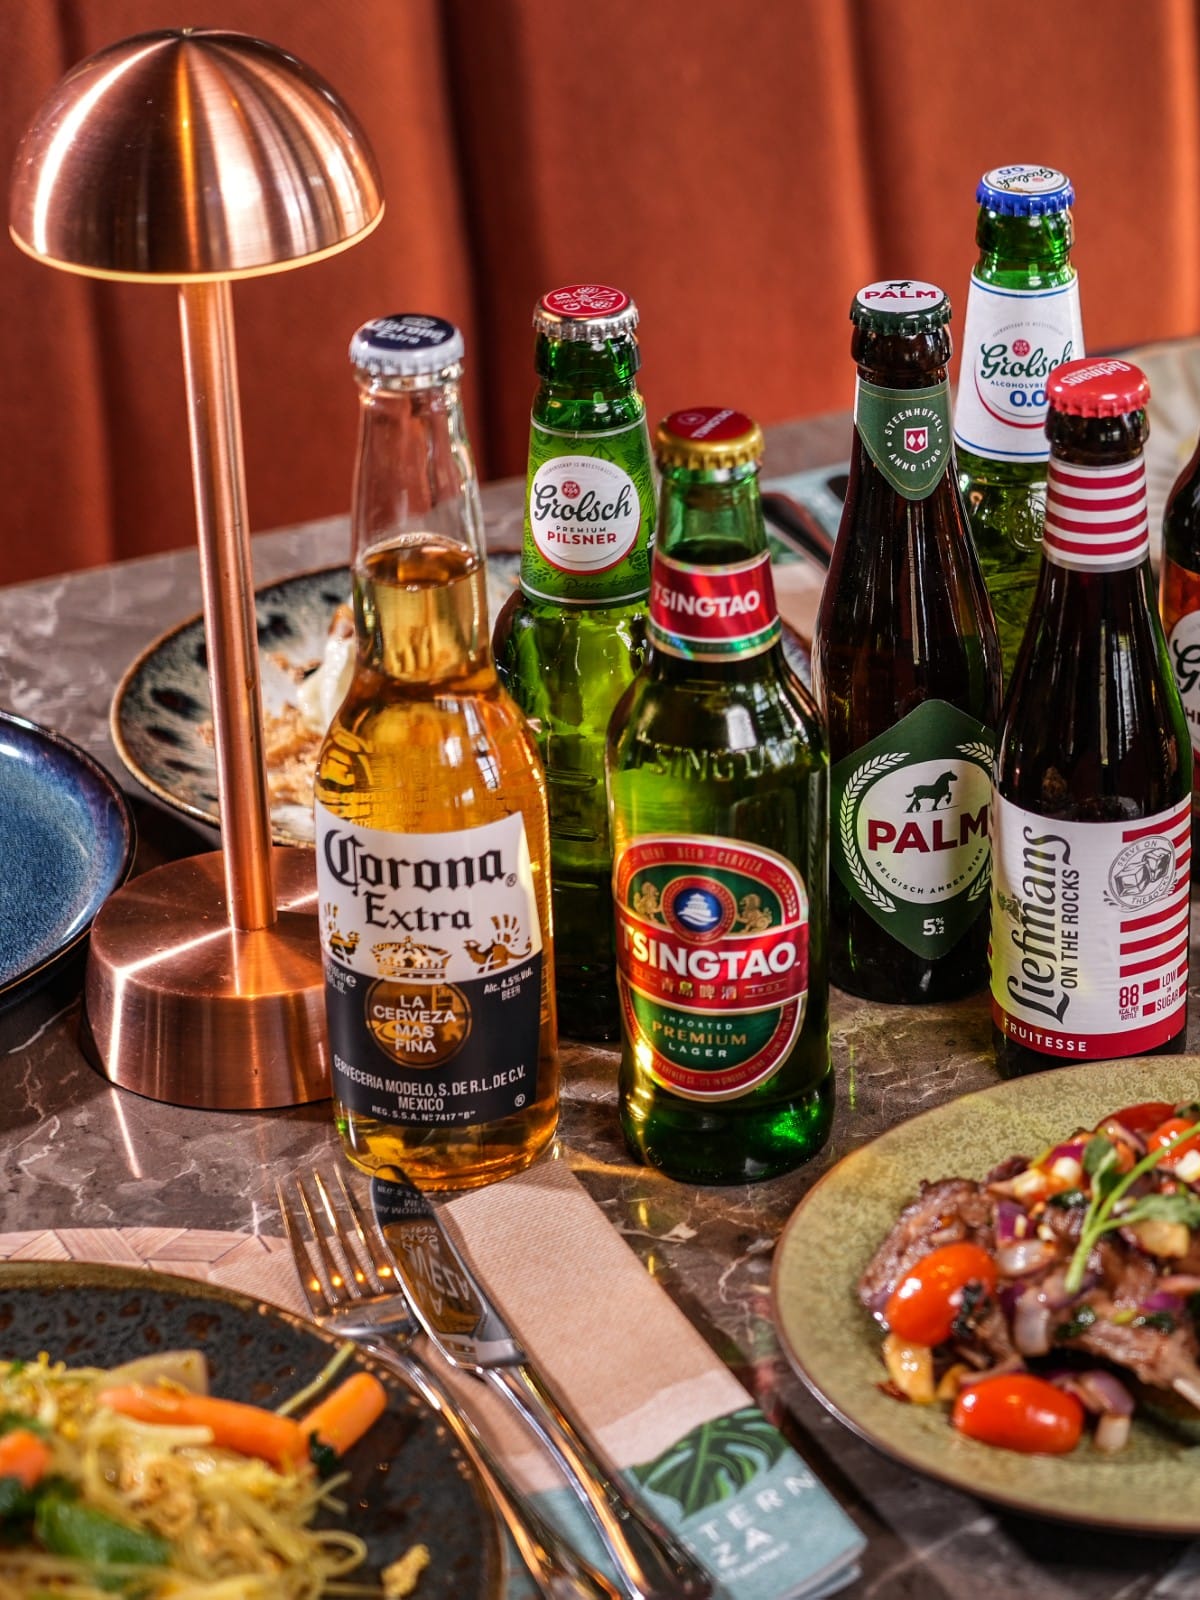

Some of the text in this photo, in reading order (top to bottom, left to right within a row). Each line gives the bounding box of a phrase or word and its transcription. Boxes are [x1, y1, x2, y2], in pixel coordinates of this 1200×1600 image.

[864, 290, 938, 299] PALM
[980, 340, 1073, 379] Grolsch
[990, 380, 1046, 389] ALCOHOLVRI
[1009, 390, 1048, 408] 0.0
[884, 407, 944, 436] STEENHUFFEL
[888, 453, 917, 472] ANNO
[534, 482, 633, 522] Grolsch
[547, 531, 617, 545] PILSNER
[556, 525, 607, 533] PREMIUM
[653, 581, 761, 618] TSINGTAO
[867, 806, 990, 854] PALM
[1144, 840, 1158, 848] ON
[324, 829, 506, 897] Corona
[875, 860, 924, 895] BELGISCH
[930, 874, 966, 895] AMBER
[363, 891, 473, 932] Extra
[1006, 826, 1071, 1025] Liefmans
[1060, 869, 1081, 989] ON THE ROCKS
[620, 918, 797, 980] TSINGTAO
[1162, 969, 1177, 988] LOW
[400, 995, 426, 1009] LA
[1119, 983, 1140, 1008] 88
[1157, 989, 1179, 1011] SUGAR
[372, 1005, 457, 1025] CERVEZA
[662, 1014, 734, 1031] IMPORTED
[394, 1023, 435, 1039] MAS
[652, 1020, 747, 1046] PREMIUM
[1004, 1018, 1087, 1053] FRUITESSE
[395, 1038, 437, 1054] FINA
[668, 1042, 728, 1058] LAGER
[333, 1053, 384, 1091] CERVECERIA
[439, 1082, 450, 1097] S.
[452, 1080, 468, 1095] DE
[470, 1078, 492, 1094] R.L.
[492, 1071, 508, 1089] DE
[508, 1064, 526, 1083] C.V.
[398, 1095, 444, 1112] MEXICO
[435, 1113, 456, 1122] 7417
